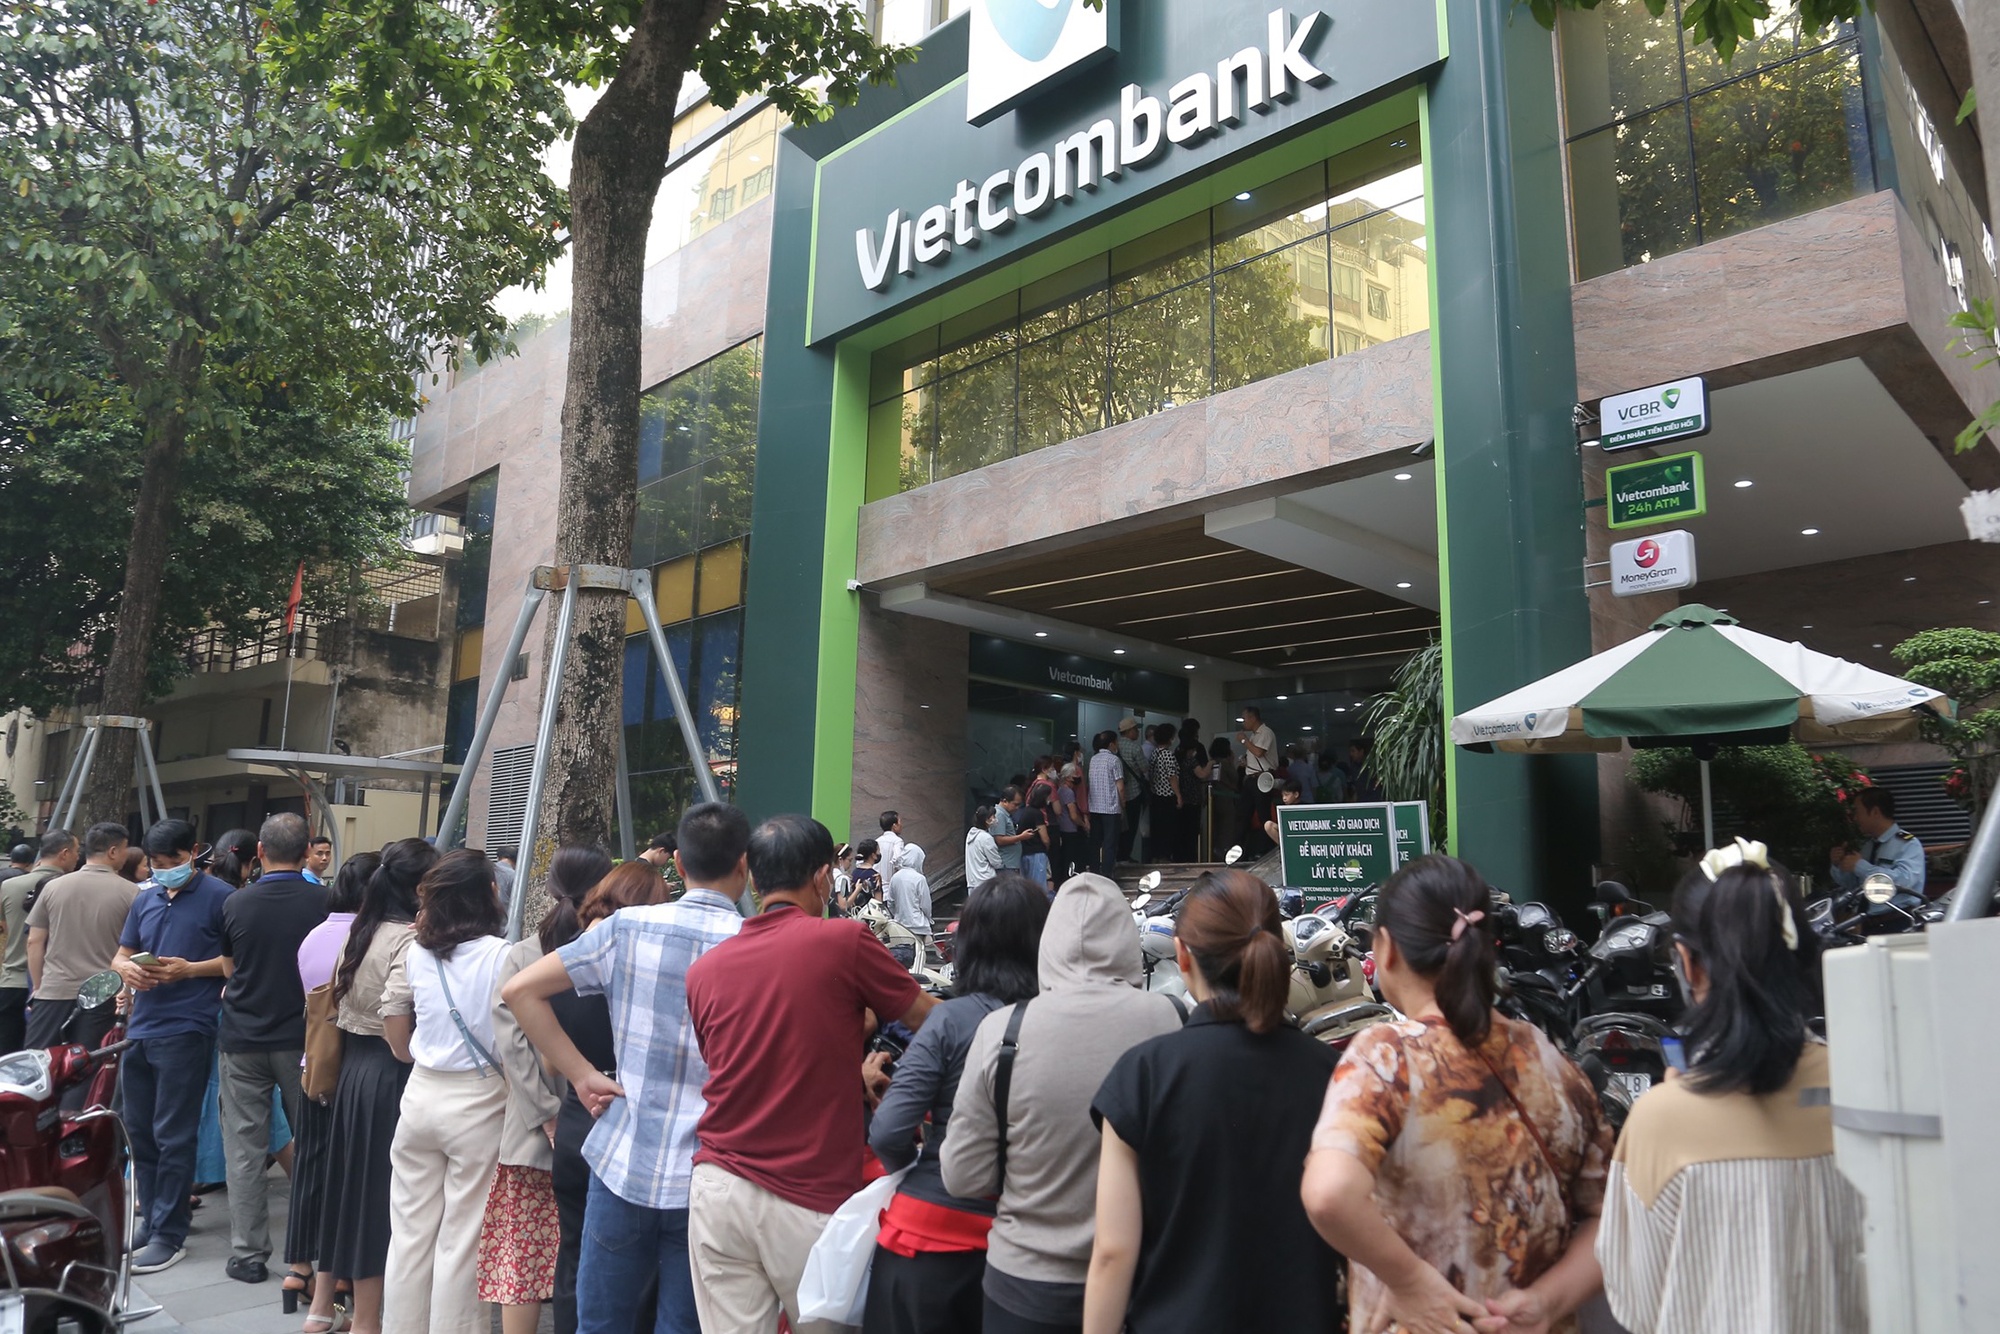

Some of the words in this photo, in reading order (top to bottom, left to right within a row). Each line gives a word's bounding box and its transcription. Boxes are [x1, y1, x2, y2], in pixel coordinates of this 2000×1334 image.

[855, 7, 1330, 291] Vietcombank
[1617, 400, 1661, 421] VCBR
[1616, 481, 1690, 503] Vietcombank
[1628, 502, 1652, 515] 24h
[1655, 497, 1680, 510] ATM
[1620, 567, 1677, 584] MoneyGram
[1048, 666, 1113, 691] Vietcombank
[1473, 719, 1521, 736] Vietcombank
[1288, 820, 1331, 831] VIETCOMBANK
[1337, 816, 1346, 830] SỞ
[1347, 819, 1363, 830] GIAO
[1364, 818, 1380, 831] DỊCH
[1396, 829, 1408, 841] ỊCH
[1310, 844, 1328, 858] NGHỊ
[1329, 842, 1345, 858] QUÝ
[1346, 841, 1373, 856] KHÁCH
[1400, 851, 1409, 861] XE
[1311, 862, 1326, 879] LẤY
